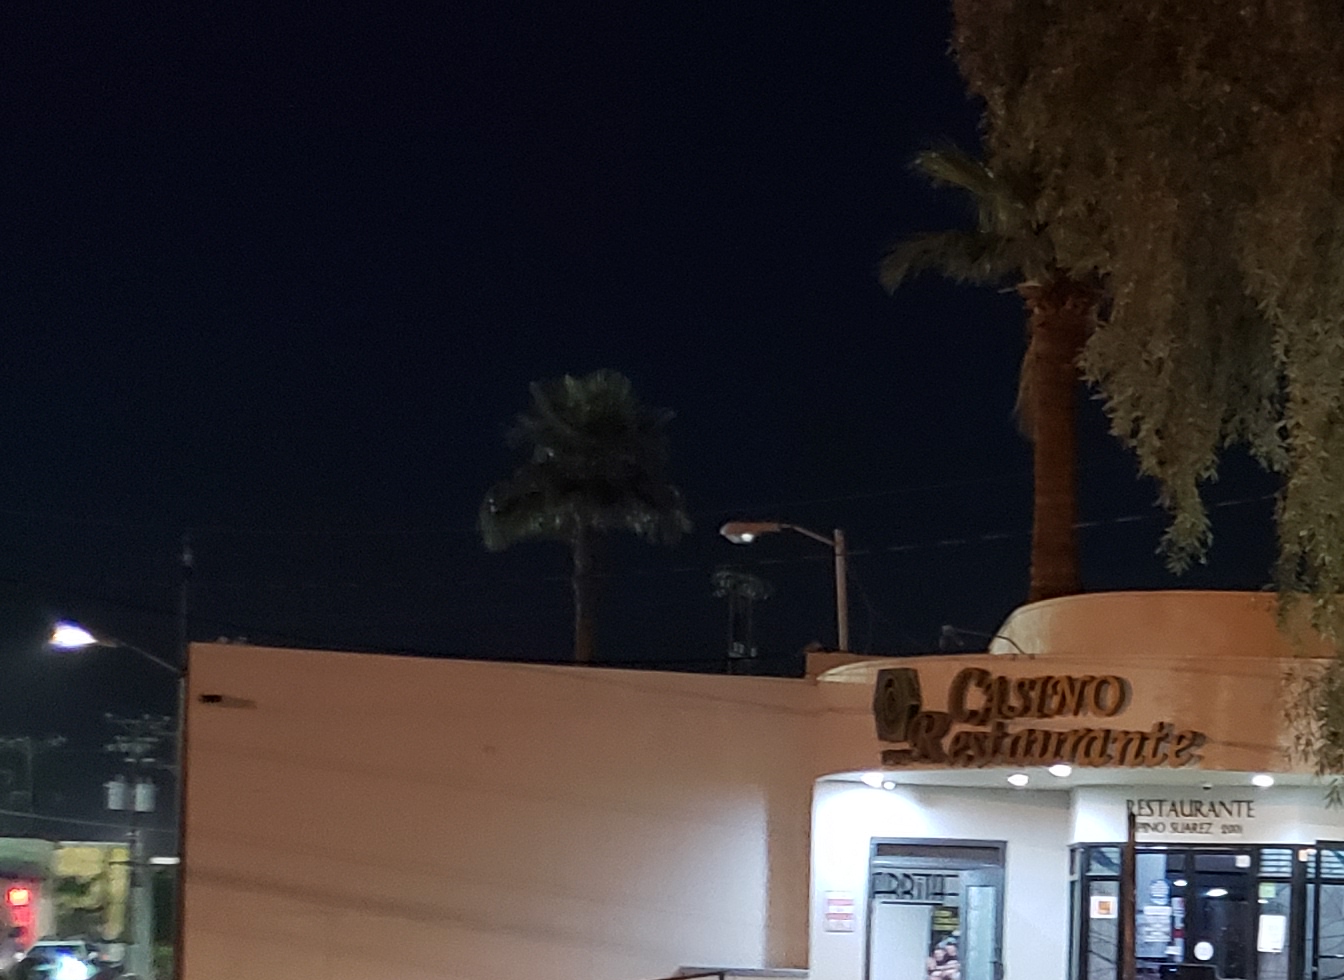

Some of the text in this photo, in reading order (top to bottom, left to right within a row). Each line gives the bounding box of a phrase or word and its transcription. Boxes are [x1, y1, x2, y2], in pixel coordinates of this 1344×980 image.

[947, 667, 1131, 726] CASINO
[907, 711, 1206, 768] Restaurante
[1126, 799, 1256, 818] RESTAURANTE
